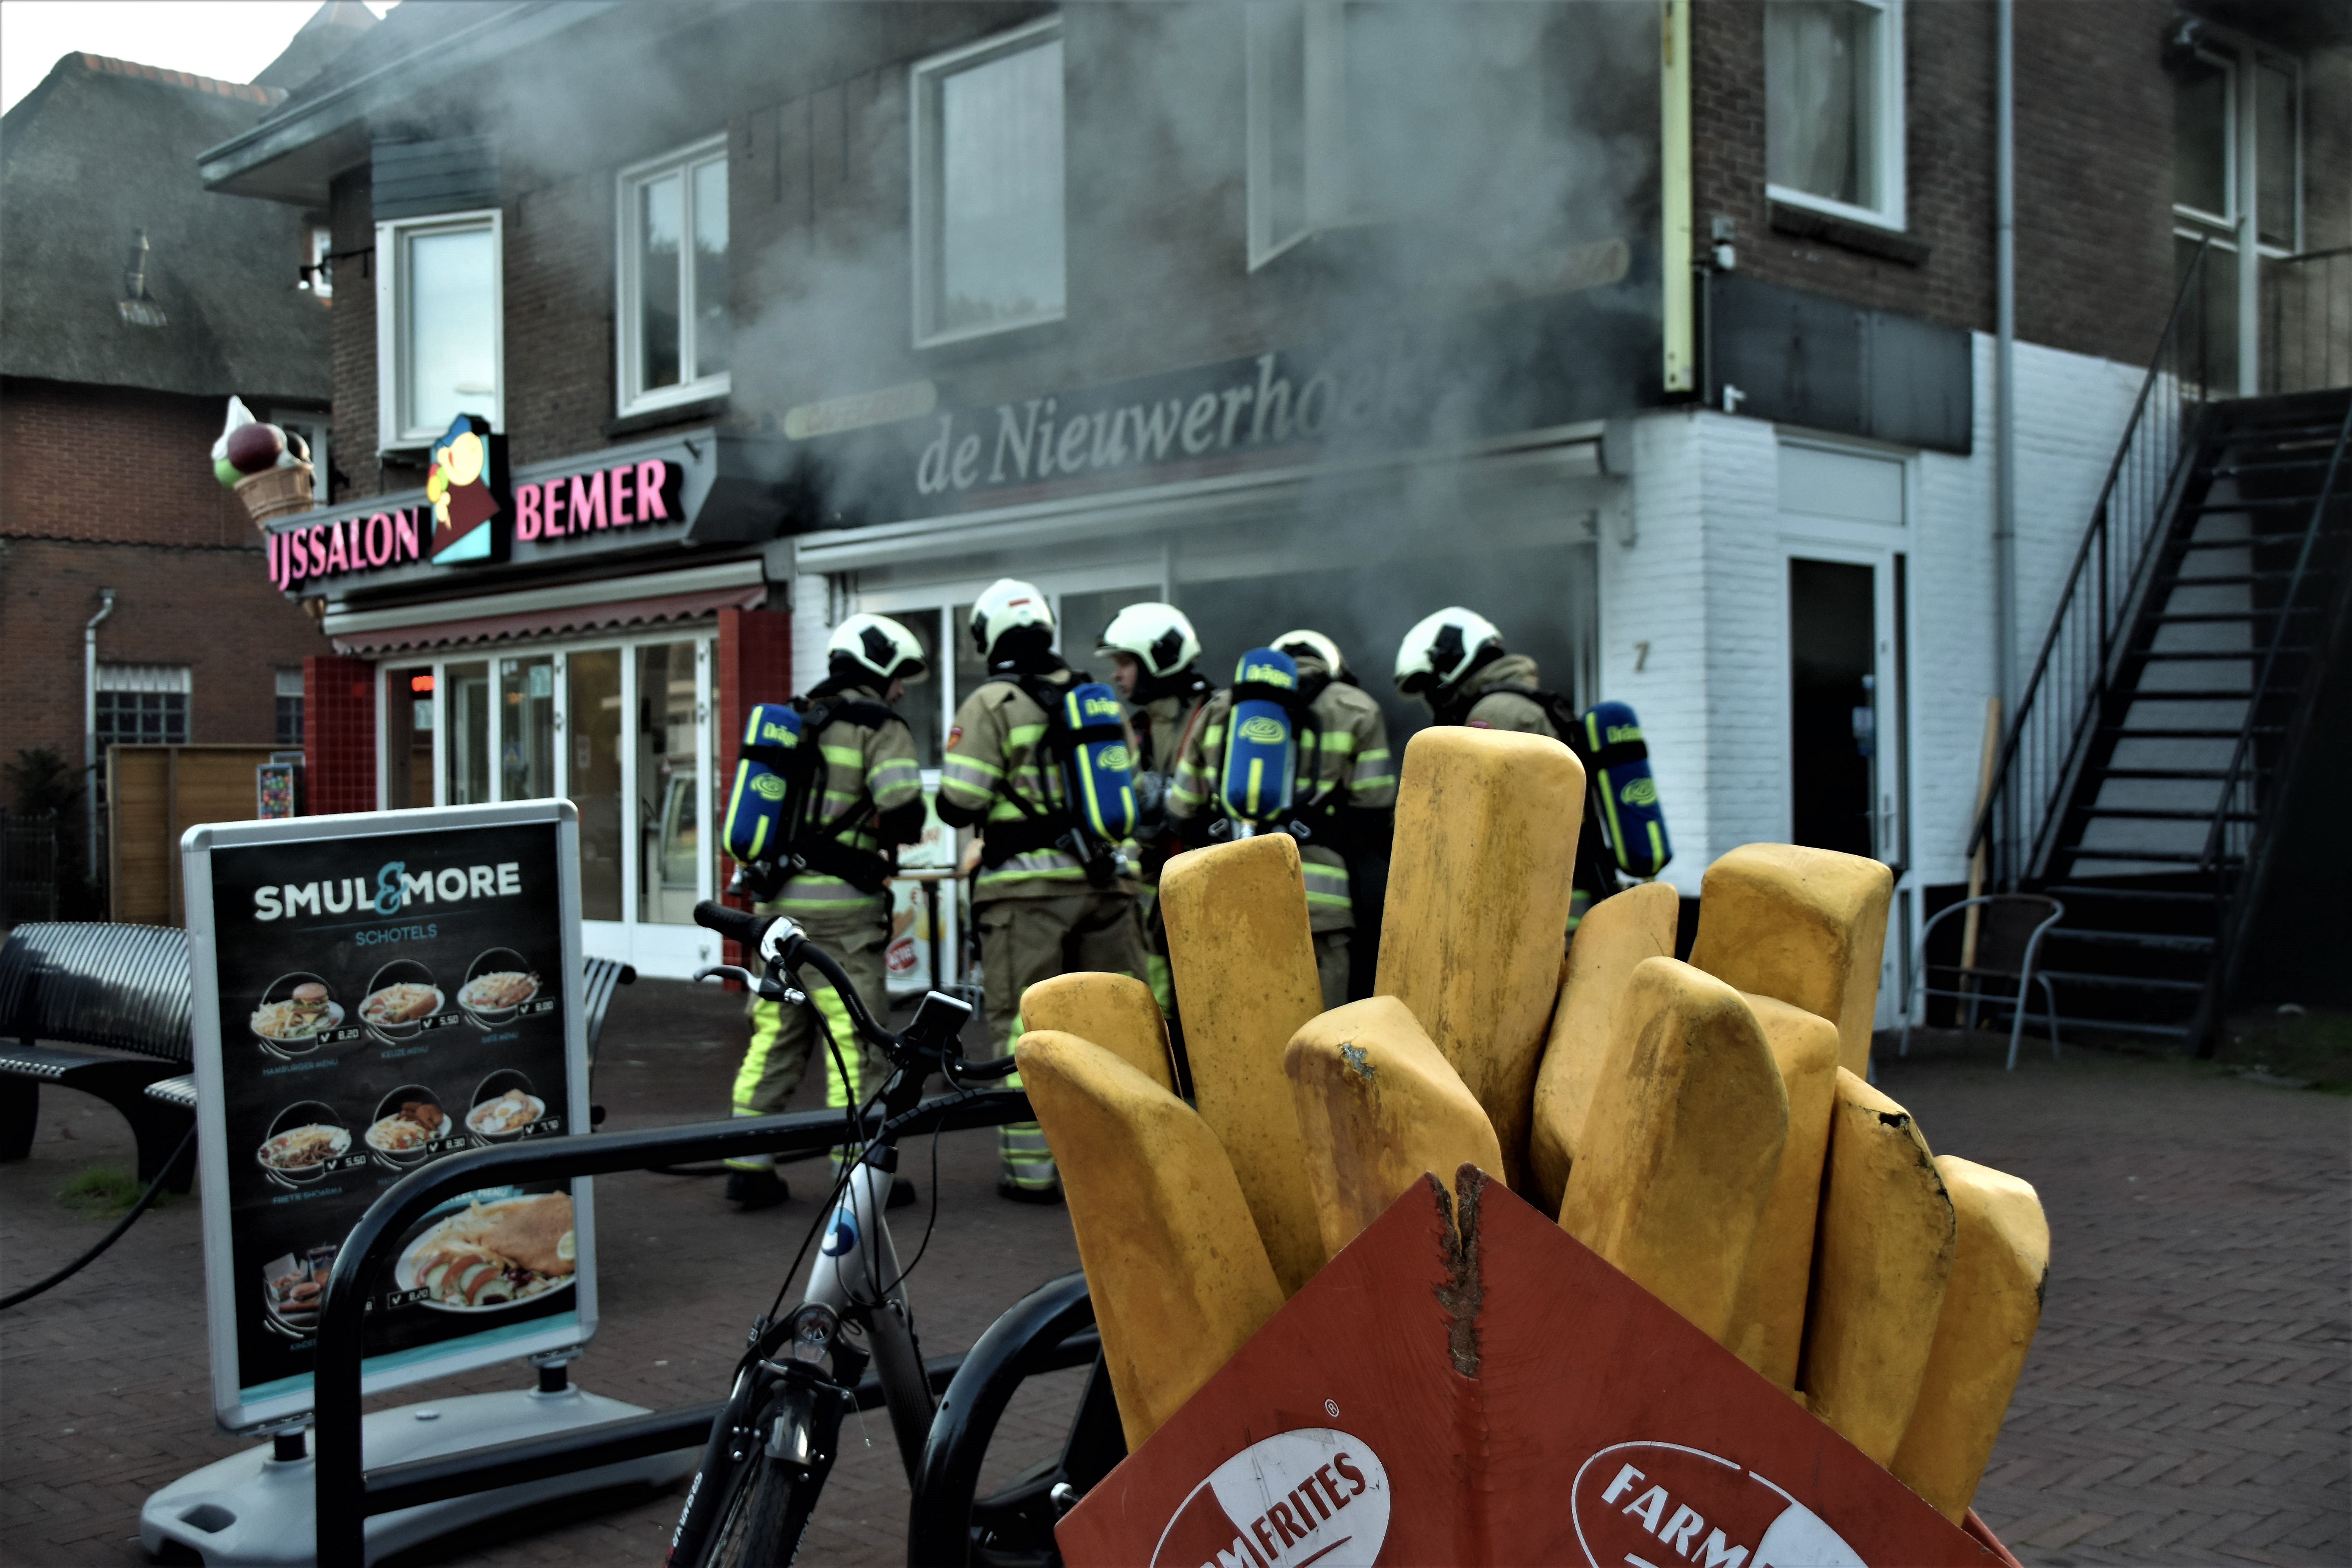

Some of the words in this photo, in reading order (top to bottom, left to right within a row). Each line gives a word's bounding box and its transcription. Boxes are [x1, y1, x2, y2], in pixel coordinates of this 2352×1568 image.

[916, 412, 981, 495] de
[269, 506, 419, 592] IJSSALON
[516, 458, 668, 541] BEMER
[1633, 641, 1650, 673] 7
[356, 923, 437, 946] SCHOTELS
[499, 1032, 519, 1040] MENU
[407, 1045, 428, 1054] MENU
[262, 1062, 314, 1076] HAMBURGER
[316, 1058, 339, 1068] MENU
[303, 1185, 343, 1199] SHOARMA
[477, 1187, 509, 1198] MENU
[1250, 1452, 1367, 1561] FRITES
[1601, 1463, 1750, 1568] FARM
